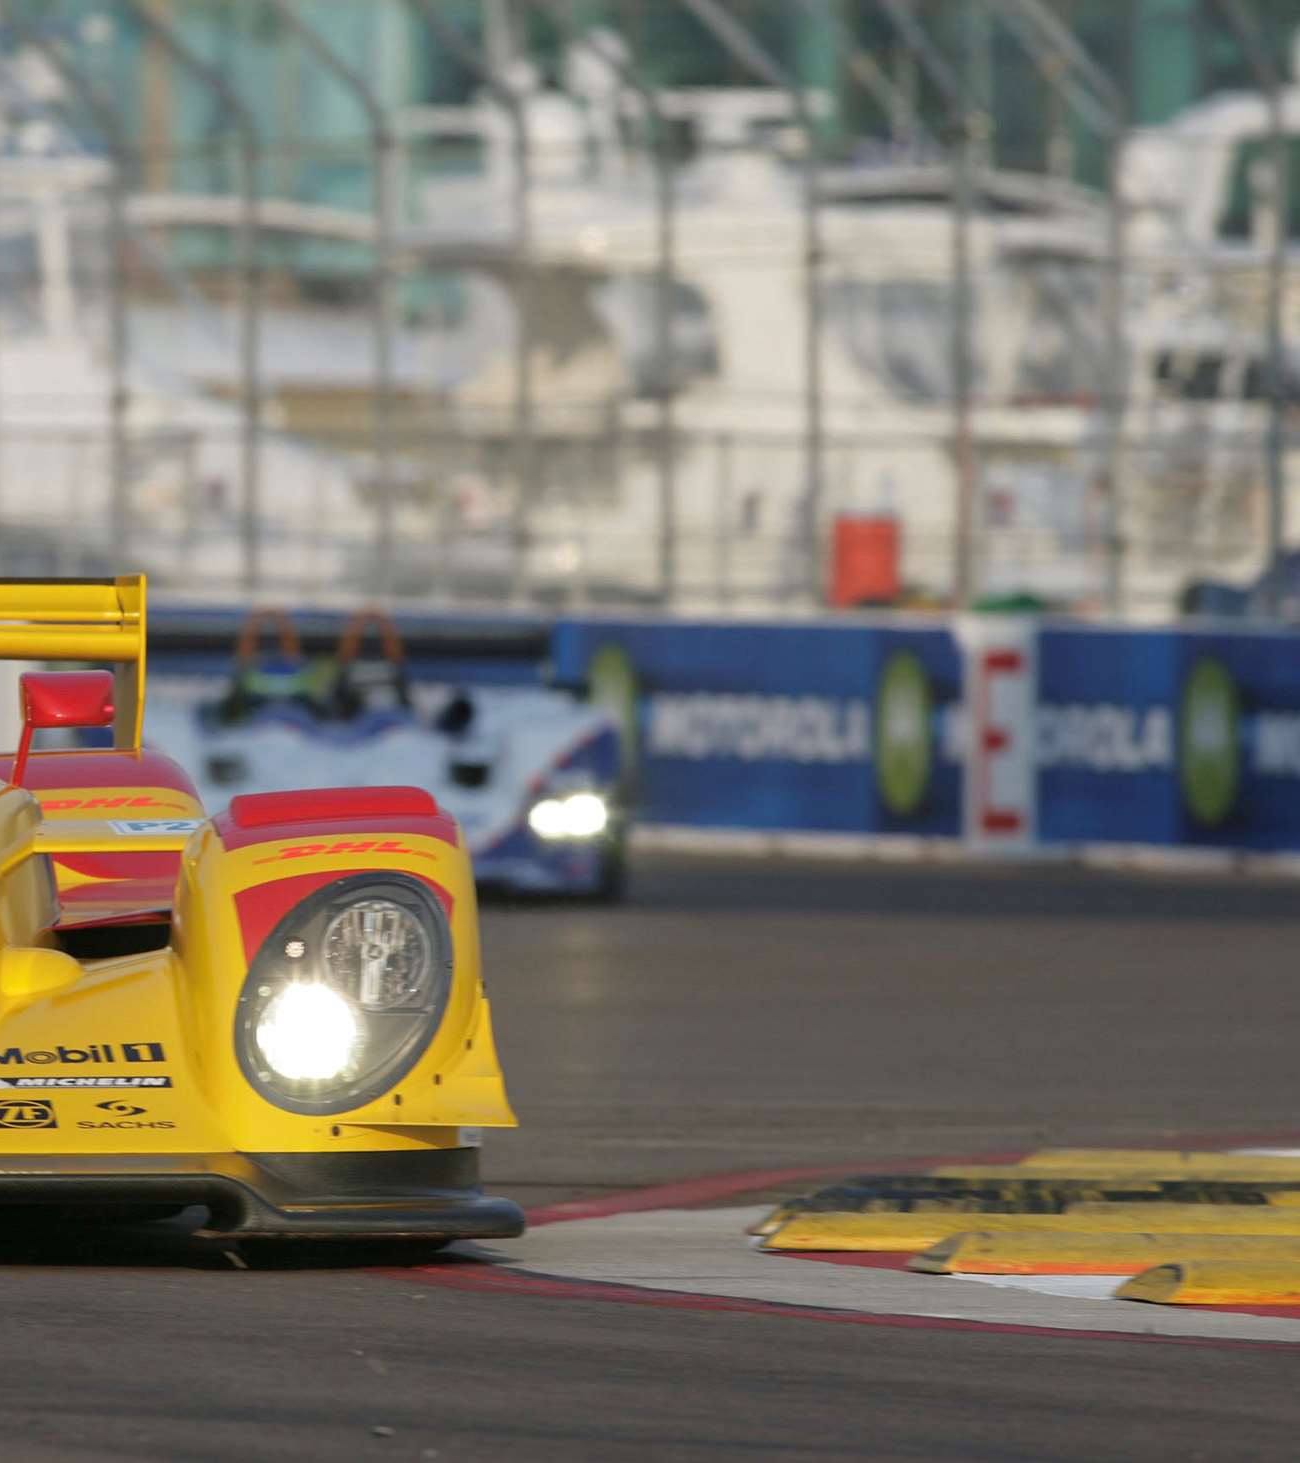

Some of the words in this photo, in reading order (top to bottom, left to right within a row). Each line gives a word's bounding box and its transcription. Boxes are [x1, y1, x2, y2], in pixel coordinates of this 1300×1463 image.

[41, 796, 159, 811] DHL
[126, 821, 197, 831] P2
[279, 840, 413, 859] DHL
[124, 1043, 164, 1062] 1
[15, 1077, 168, 1087] MICHELIN
[76, 1120, 176, 1129] SACHS
